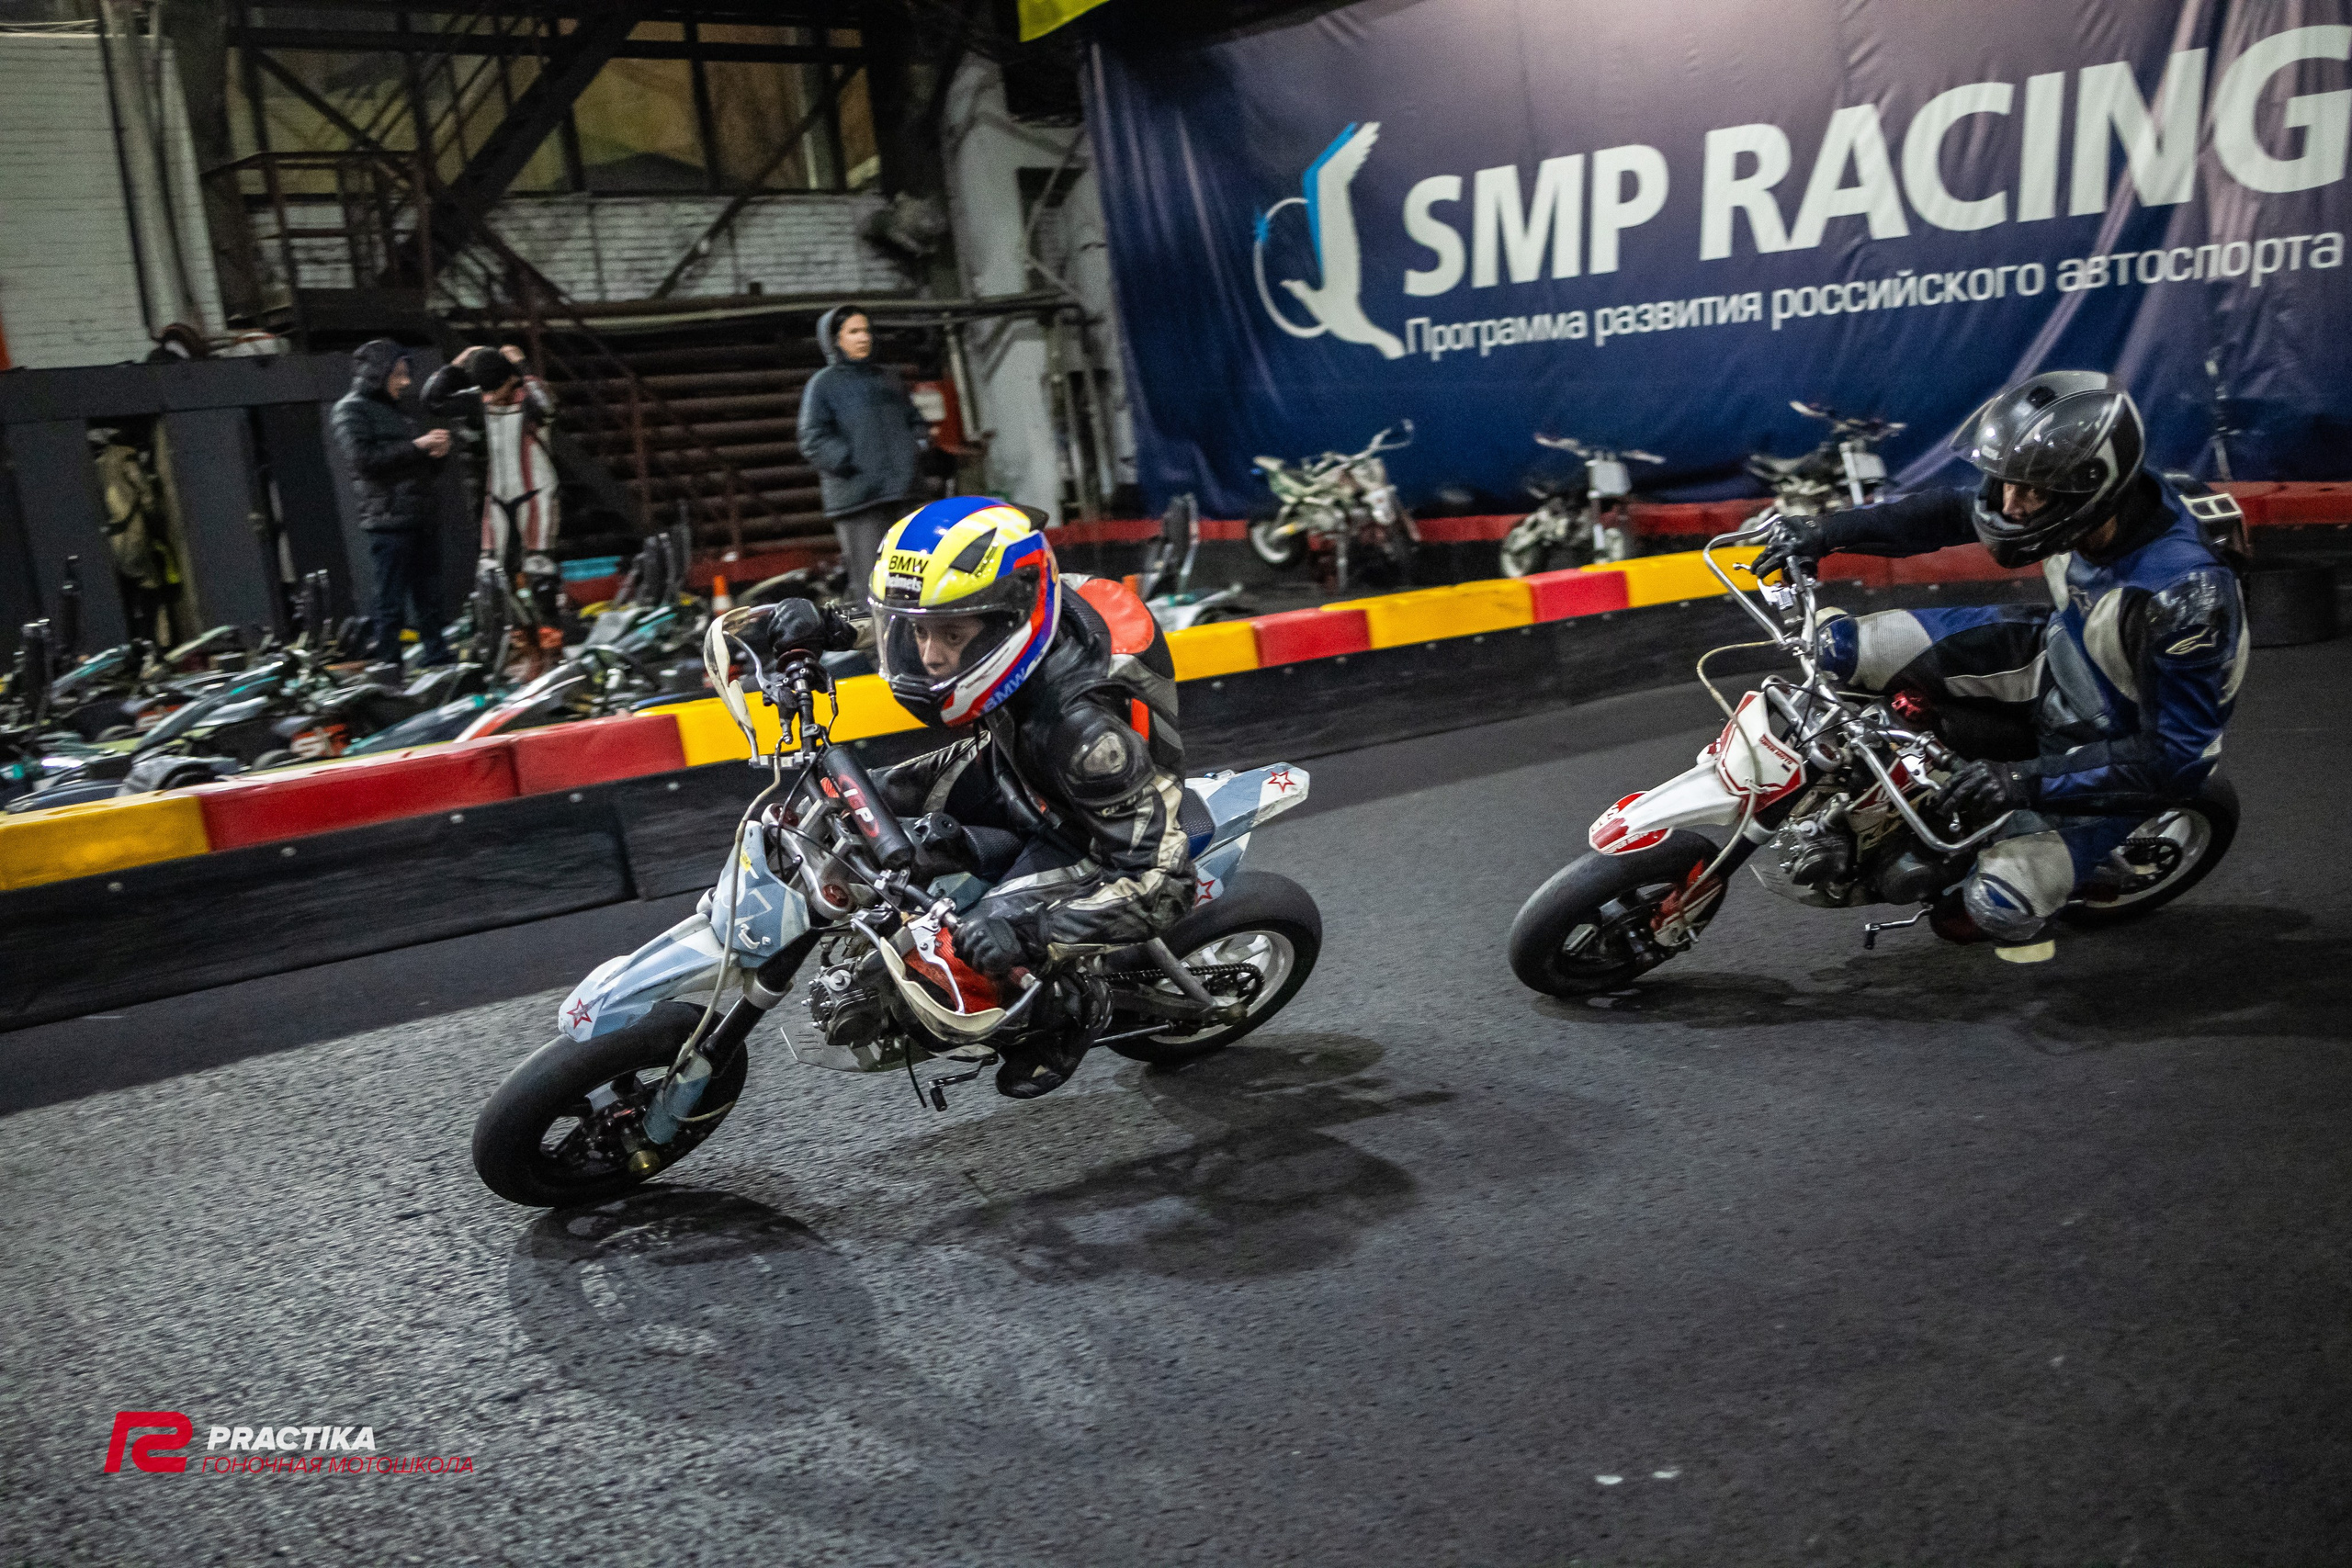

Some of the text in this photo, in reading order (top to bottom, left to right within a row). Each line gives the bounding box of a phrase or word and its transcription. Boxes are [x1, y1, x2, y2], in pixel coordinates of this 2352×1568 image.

[1403, 25, 2352, 297] SMP RACING
[1404, 231, 2346, 361] Программа развития российского автоспорта
[888, 555, 929, 574] BMW
[982, 667, 1026, 713] BMW
